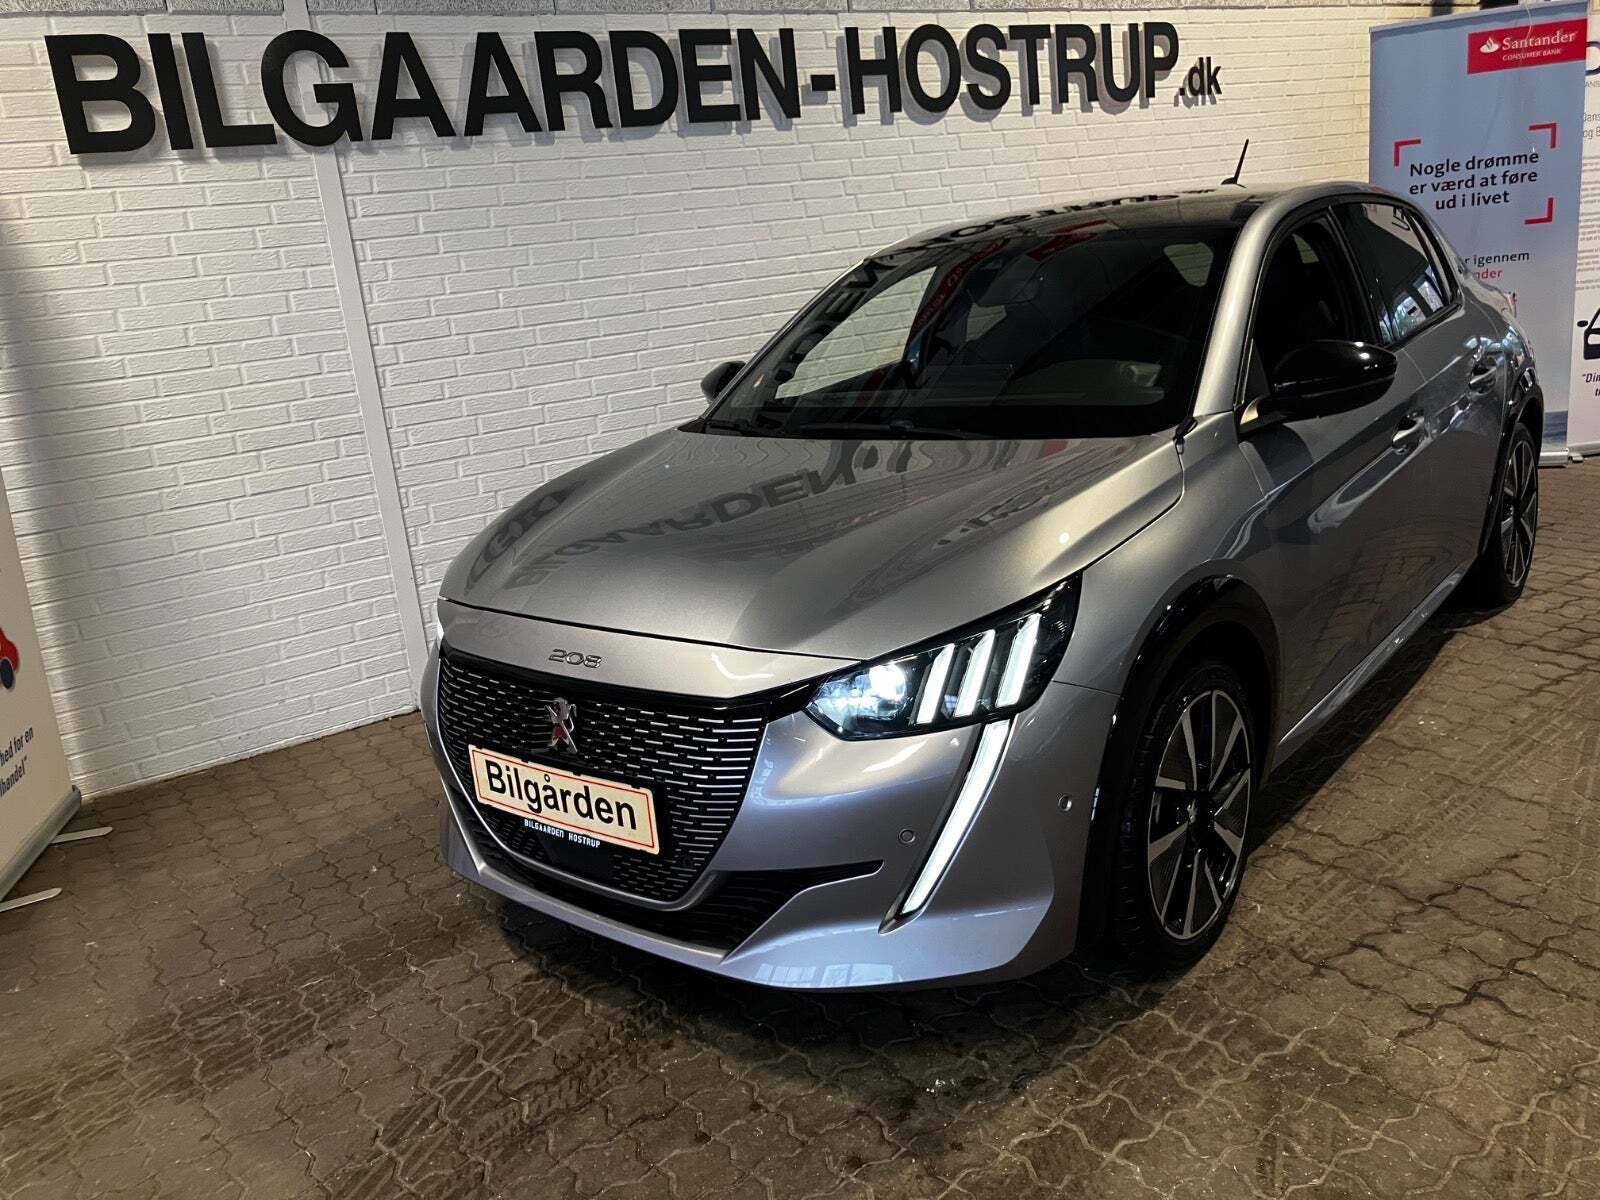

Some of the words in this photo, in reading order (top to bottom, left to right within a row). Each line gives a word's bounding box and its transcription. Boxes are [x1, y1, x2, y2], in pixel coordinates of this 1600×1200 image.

[1502, 29, 1578, 51] Santander
[1502, 50, 1541, 61] CONSUMER
[1543, 48, 1561, 57] BANK
[1410, 158, 1460, 178] Nogle
[1465, 152, 1539, 169] drømme
[1409, 184, 1427, 195] er
[1431, 174, 1475, 192] værd
[1479, 174, 1497, 187] at
[1502, 170, 1538, 184] føre
[1436, 195, 1456, 210] ud
[1461, 194, 1467, 207] i
[1471, 190, 1510, 206] livet
[1473, 252, 1530, 268] igennem
[1472, 268, 1503, 279] nder
[549, 648, 602, 668] 208
[14, 736, 23, 753] for
[25, 727, 34, 743] en
[485, 759, 637, 831] Bilgården
[524, 819, 564, 838] BILGAARDEN
[568, 832, 600, 848] HOSTRUP
